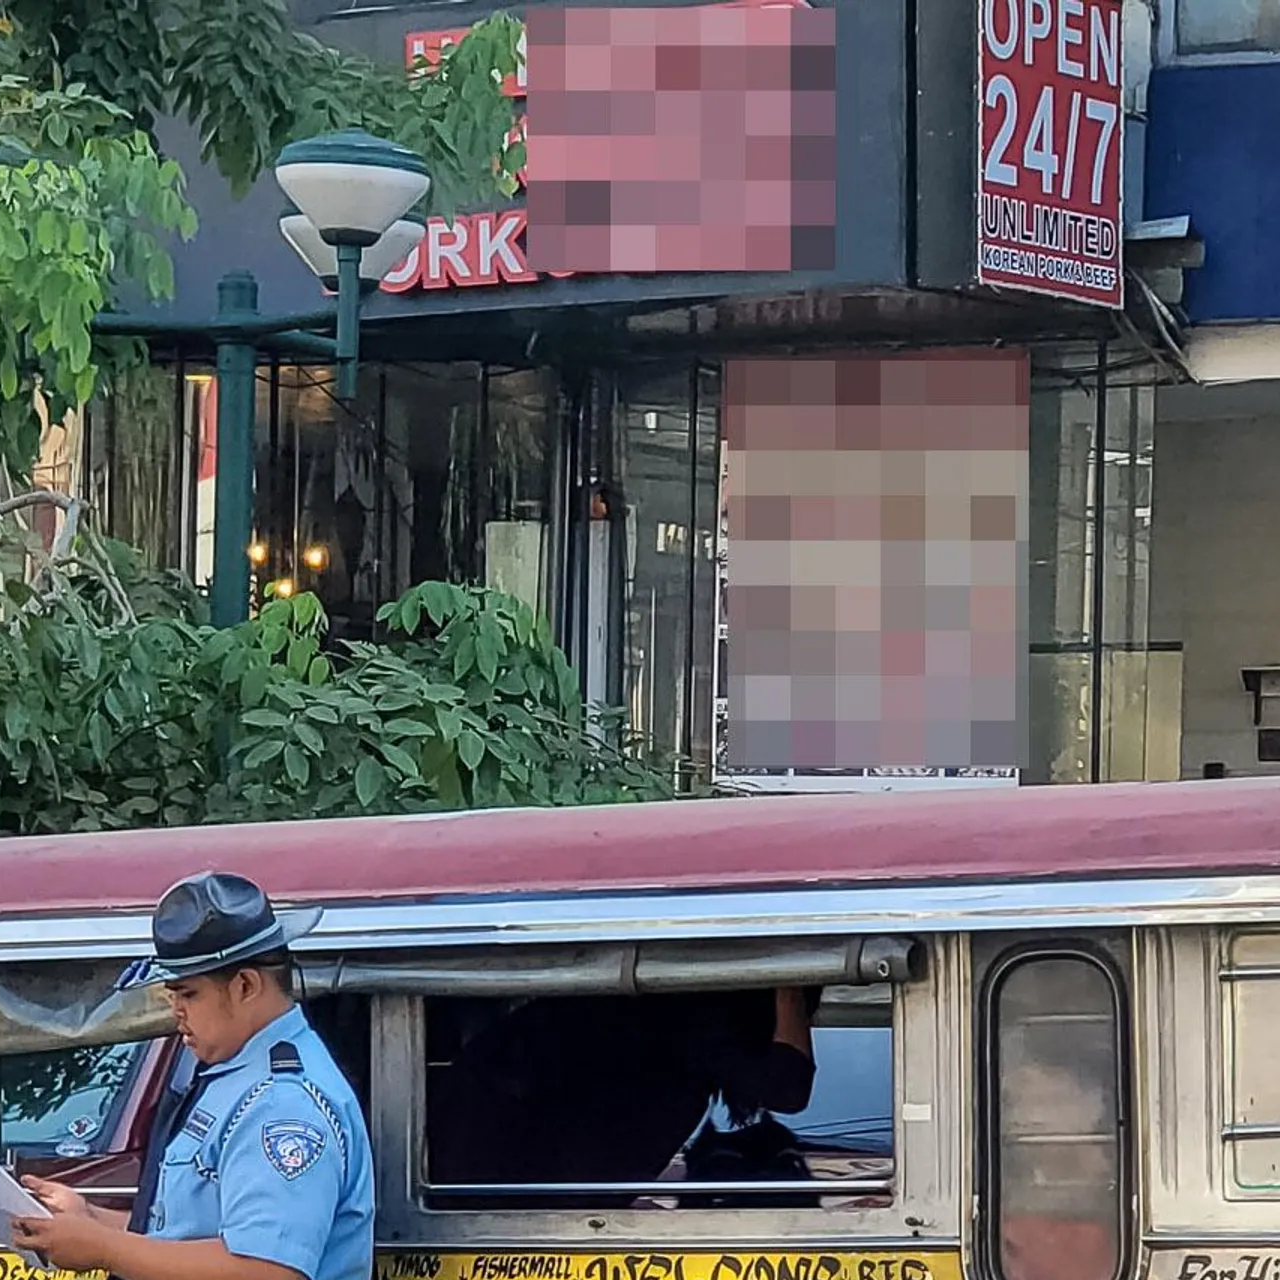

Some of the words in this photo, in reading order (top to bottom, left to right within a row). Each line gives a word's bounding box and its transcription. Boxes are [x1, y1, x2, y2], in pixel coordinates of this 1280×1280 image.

[985, 0, 1118, 87] OPEN
[984, 73, 1117, 204] 24/7
[982, 193, 1117, 260] UNLIMITED
[983, 244, 1036, 277] KOREAN
[1037, 253, 1073, 283] PORK
[1083, 264, 1117, 290] BEEF
[384, 1255, 442, 1279] TIMOG
[471, 1255, 573, 1280] FISHERMALL
